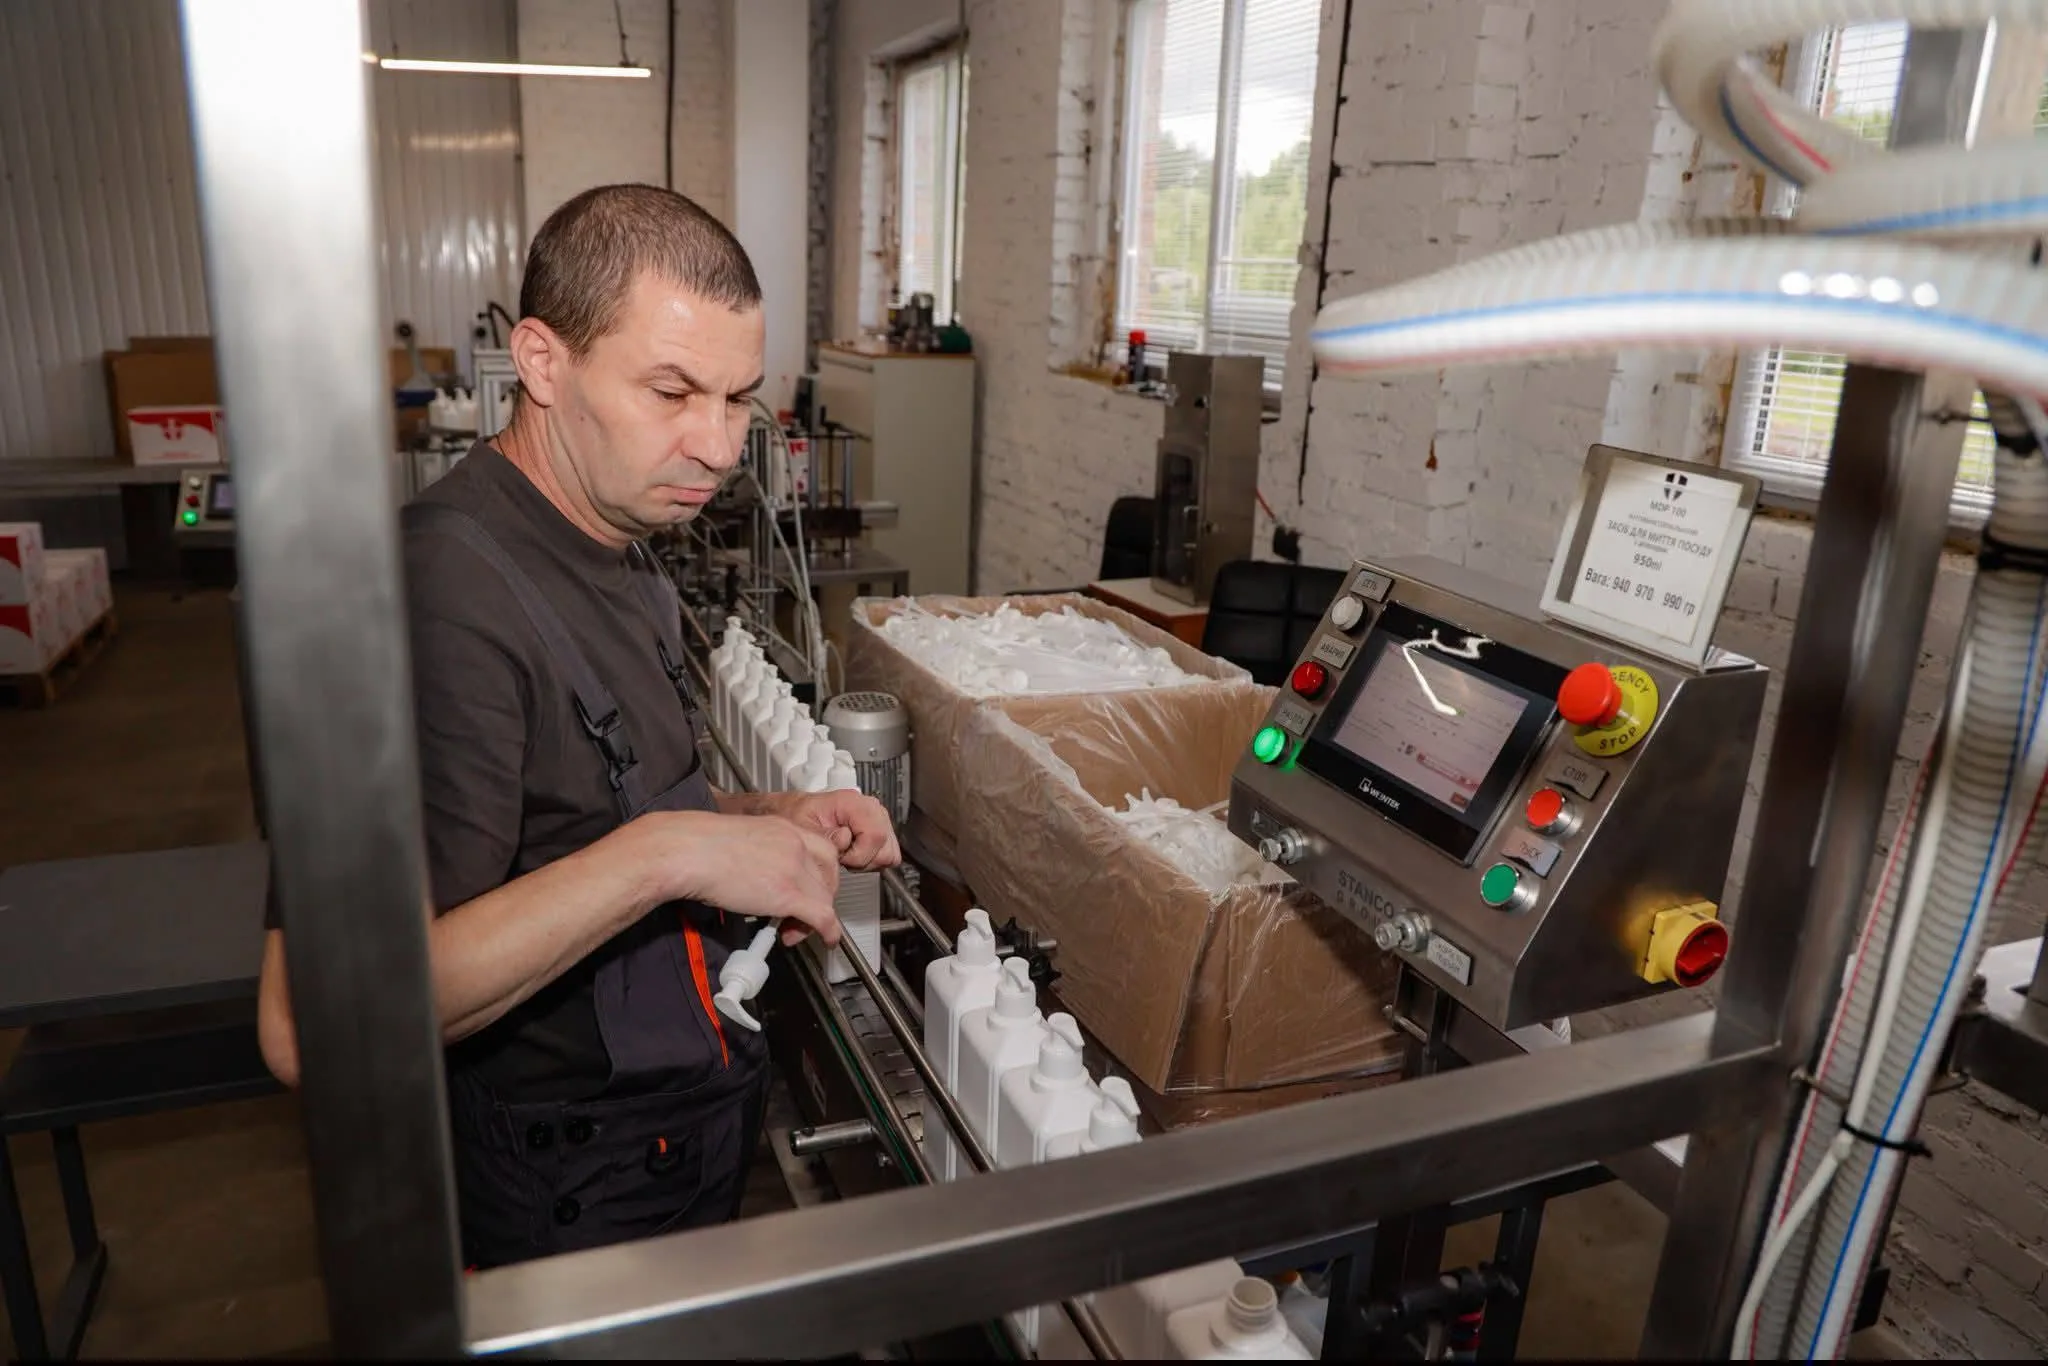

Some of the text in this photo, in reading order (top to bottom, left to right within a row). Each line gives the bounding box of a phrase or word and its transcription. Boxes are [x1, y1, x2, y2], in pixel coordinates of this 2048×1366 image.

[1672, 506, 1687, 518] 100
[1629, 527, 1648, 539] ДЛЯ
[1648, 532, 1677, 547] МИТТЯ
[1677, 539, 1713, 558] ПОСУДУ
[1585, 567, 1610, 588] Вага:
[1612, 576, 1632, 593] 940
[1635, 583, 1655, 601] 970
[1662, 592, 1683, 610] 990
[1599, 726, 1637, 750] STOP
[1338, 869, 1394, 920] STANCO
